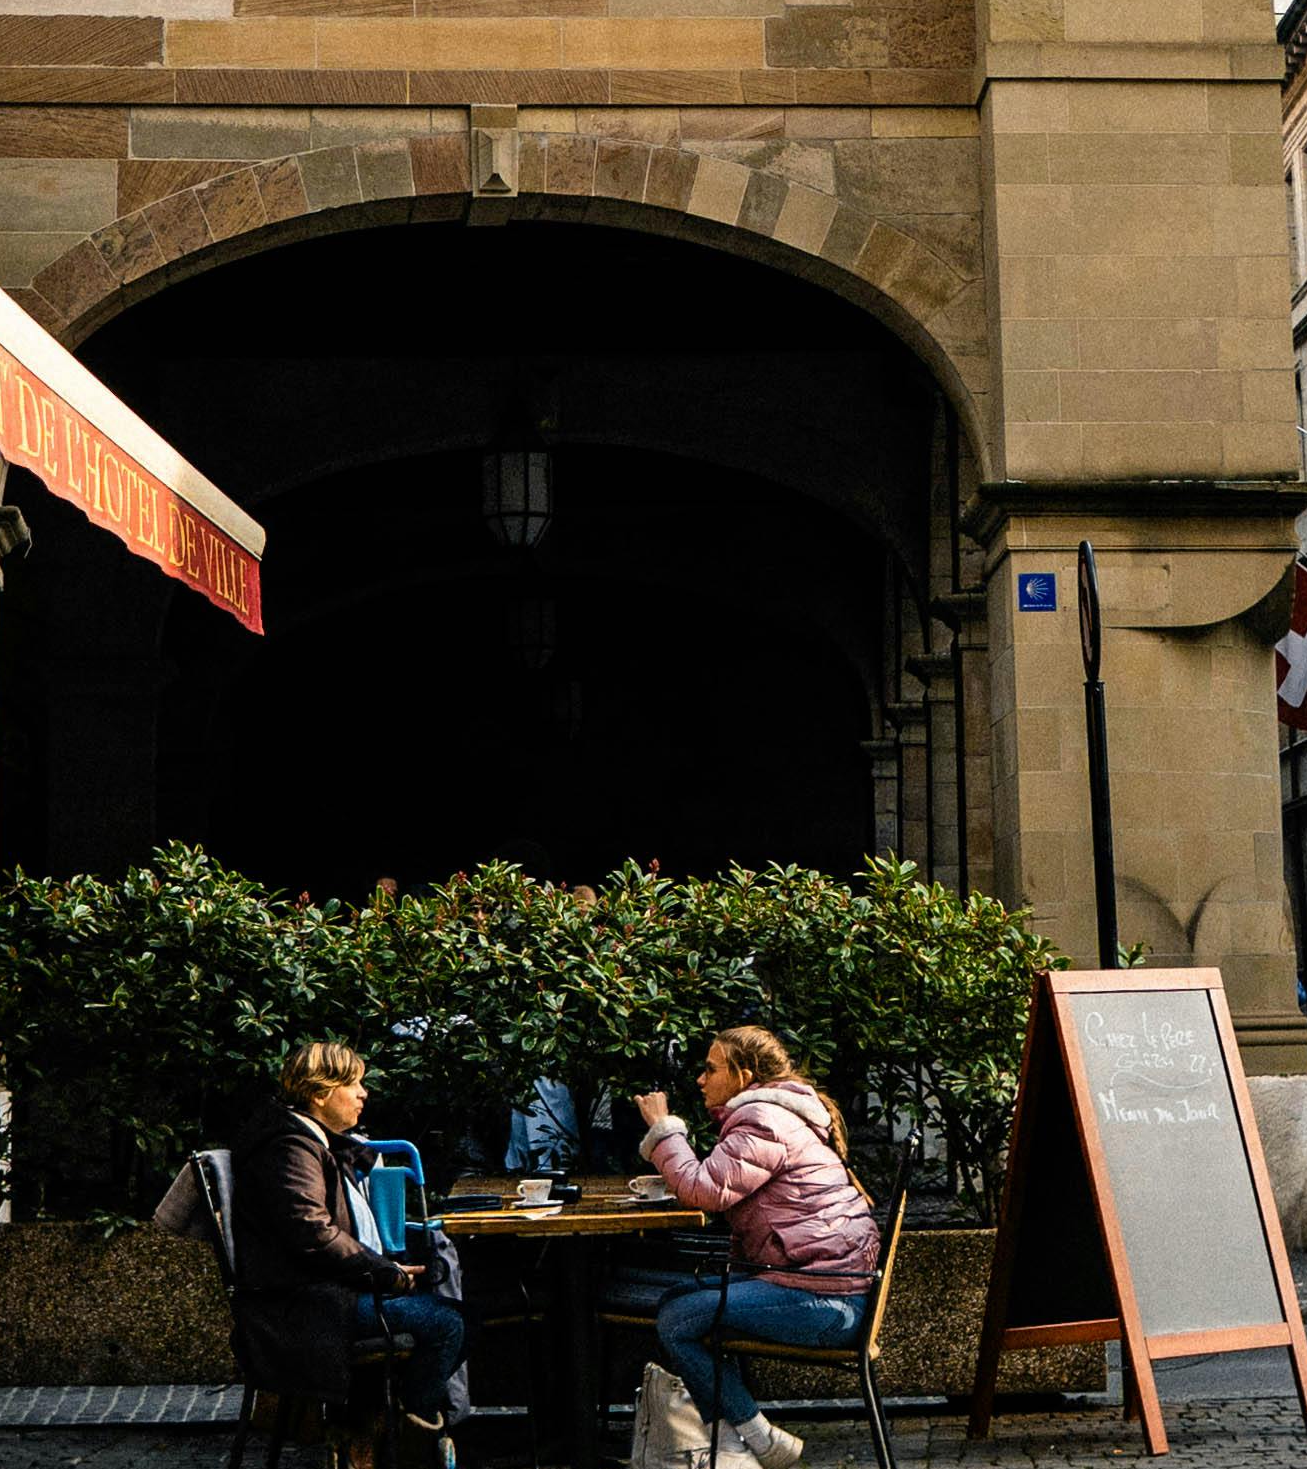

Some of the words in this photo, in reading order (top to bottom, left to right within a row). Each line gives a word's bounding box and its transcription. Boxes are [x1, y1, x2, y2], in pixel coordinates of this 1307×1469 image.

[14, 375, 58, 477] DE
[64, 415, 166, 555] L'HOTEL
[168, 502, 200, 580] DE
[201, 533, 249, 615] VILLE
